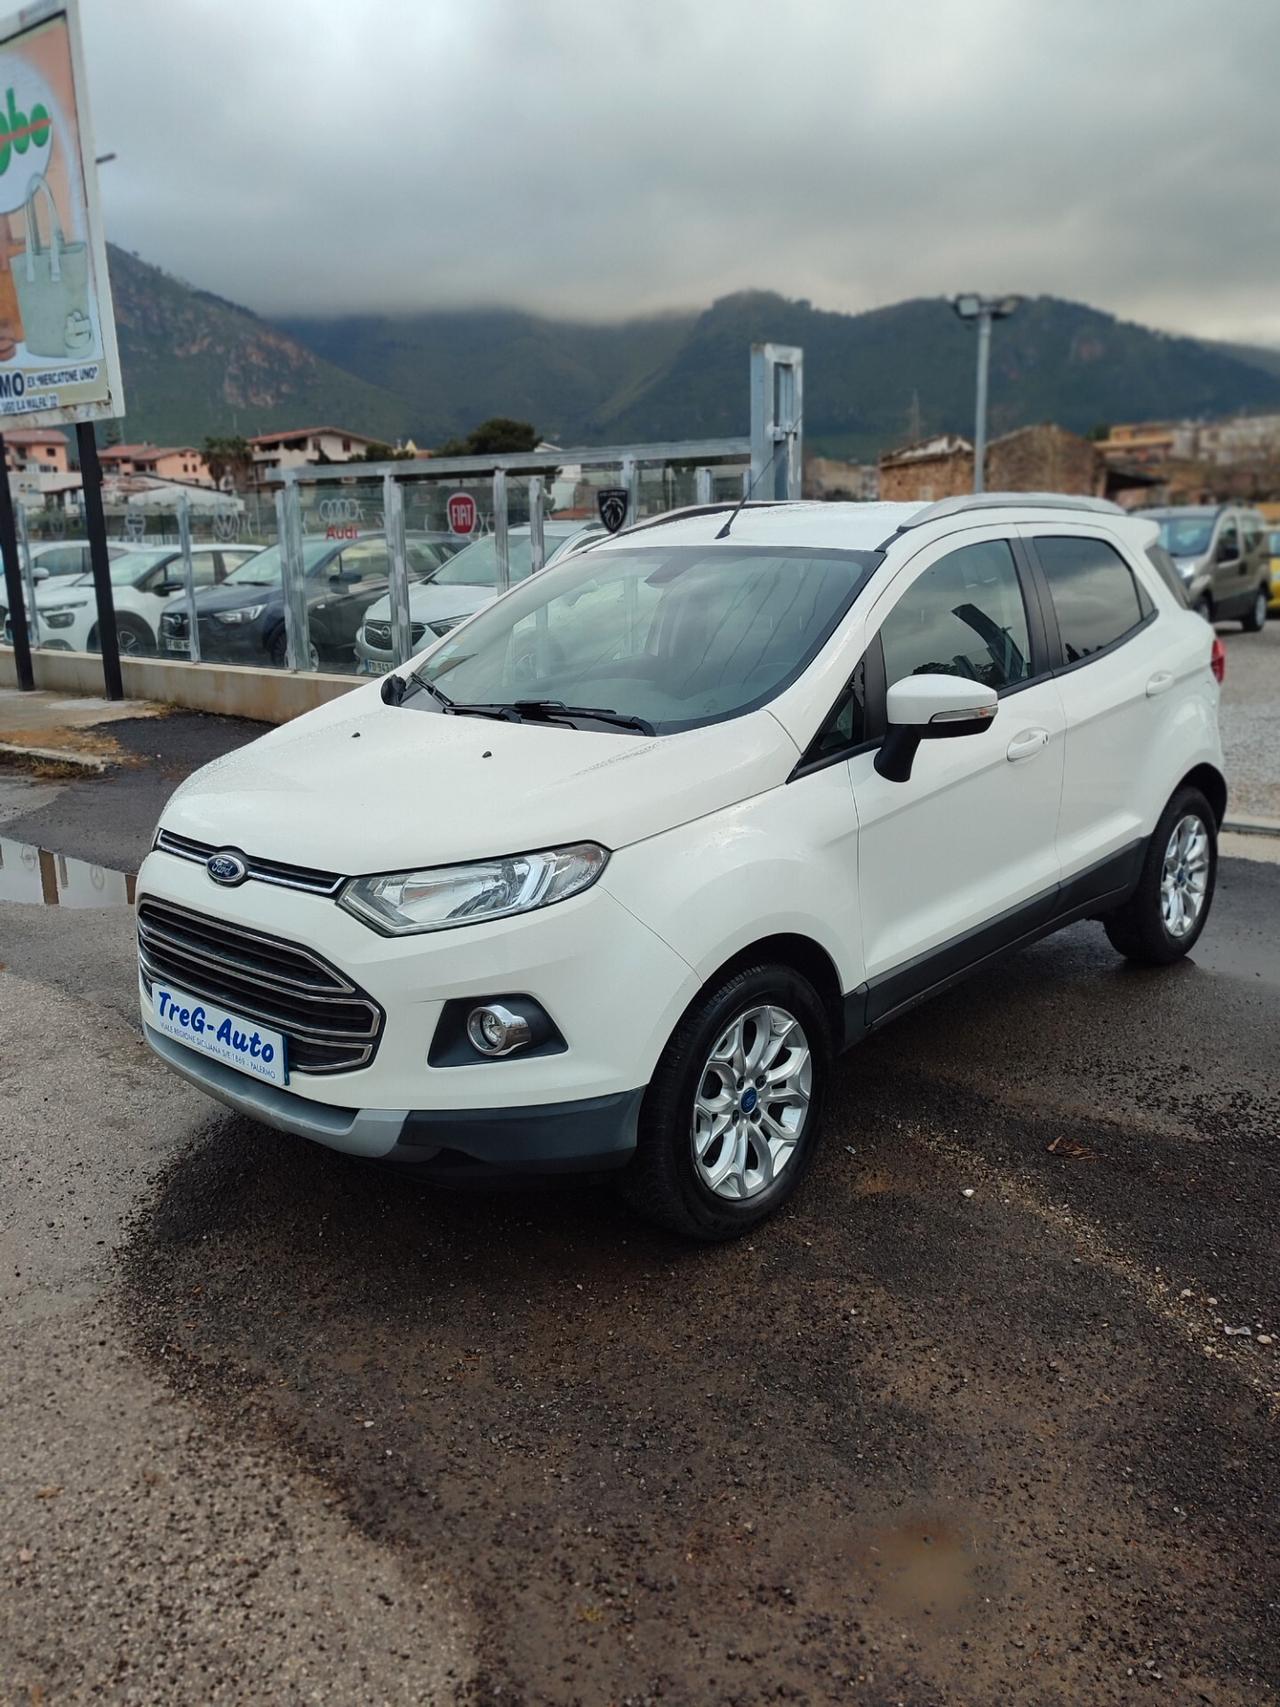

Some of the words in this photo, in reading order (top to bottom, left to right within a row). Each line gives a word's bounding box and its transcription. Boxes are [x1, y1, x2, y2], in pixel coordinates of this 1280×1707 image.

[451, 504, 472, 527] FIAT
[325, 524, 358, 540] Audi
[211, 858, 233, 875] Ford
[158, 991, 274, 1063] TreG-Auto
[250, 1061, 276, 1079] PALERMO
